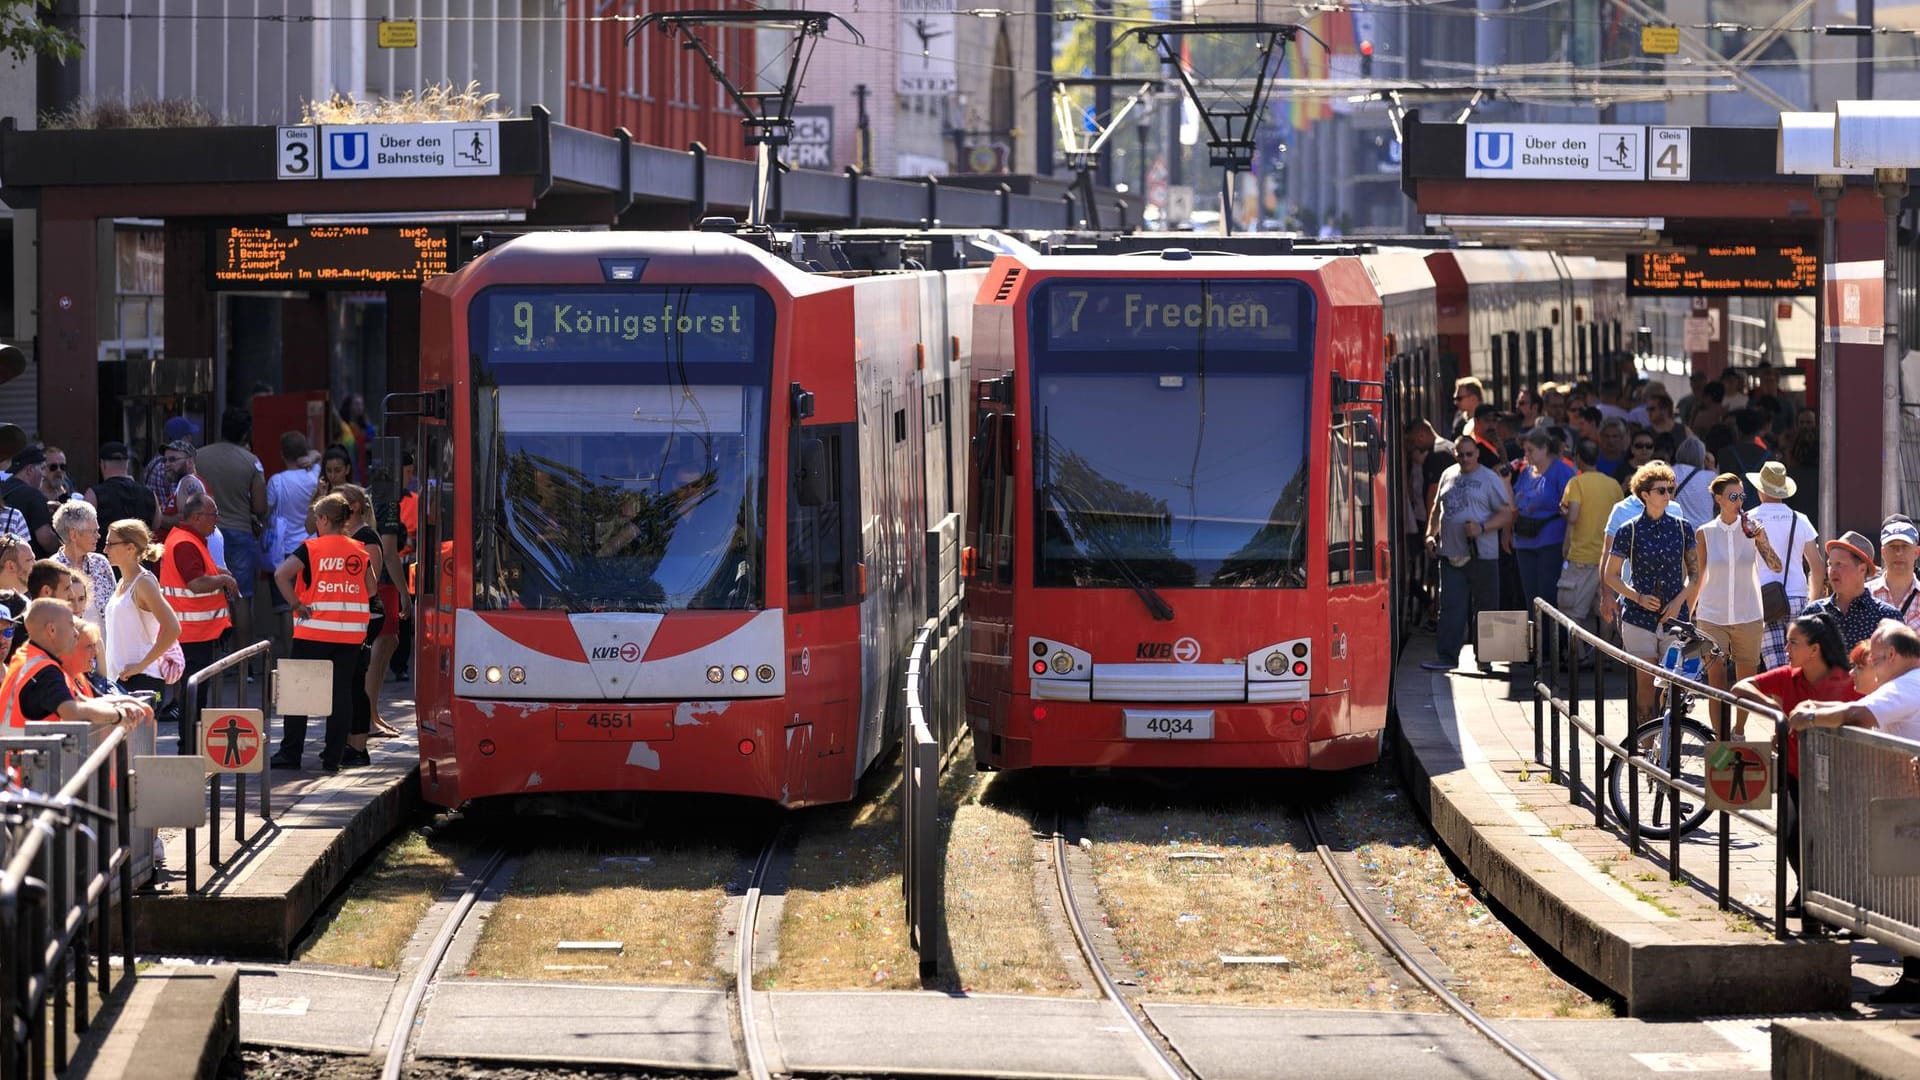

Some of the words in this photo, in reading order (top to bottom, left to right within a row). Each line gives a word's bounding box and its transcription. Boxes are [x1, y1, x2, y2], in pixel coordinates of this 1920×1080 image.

[286, 131, 308, 139] Gleis
[380, 134, 411, 148] Über
[416, 136, 441, 147] den
[1525, 135, 1556, 149] Über
[1562, 136, 1586, 149] den
[1659, 131, 1681, 140] Gleis
[285, 142, 309, 173] 3
[333, 134, 365, 168] U
[1478, 133, 1510, 168] U
[377, 153, 444, 166] Bahnsteig
[1522, 154, 1589, 168] Bahnsteig
[1656, 144, 1683, 175] 4
[415, 238, 447, 250] Sofort
[240, 248, 286, 261] Bensberg
[1068, 291, 1089, 332] 7
[1124, 294, 1269, 328] Frechen
[514, 301, 533, 345] 9
[555, 304, 741, 340] Königsforst
[318, 557, 345, 571] KVB
[318, 580, 360, 594] Service
[592, 647, 619, 659] KVB
[1136, 642, 1172, 658] KVB
[586, 713, 633, 728] 4551
[1146, 718, 1194, 733] 4034
